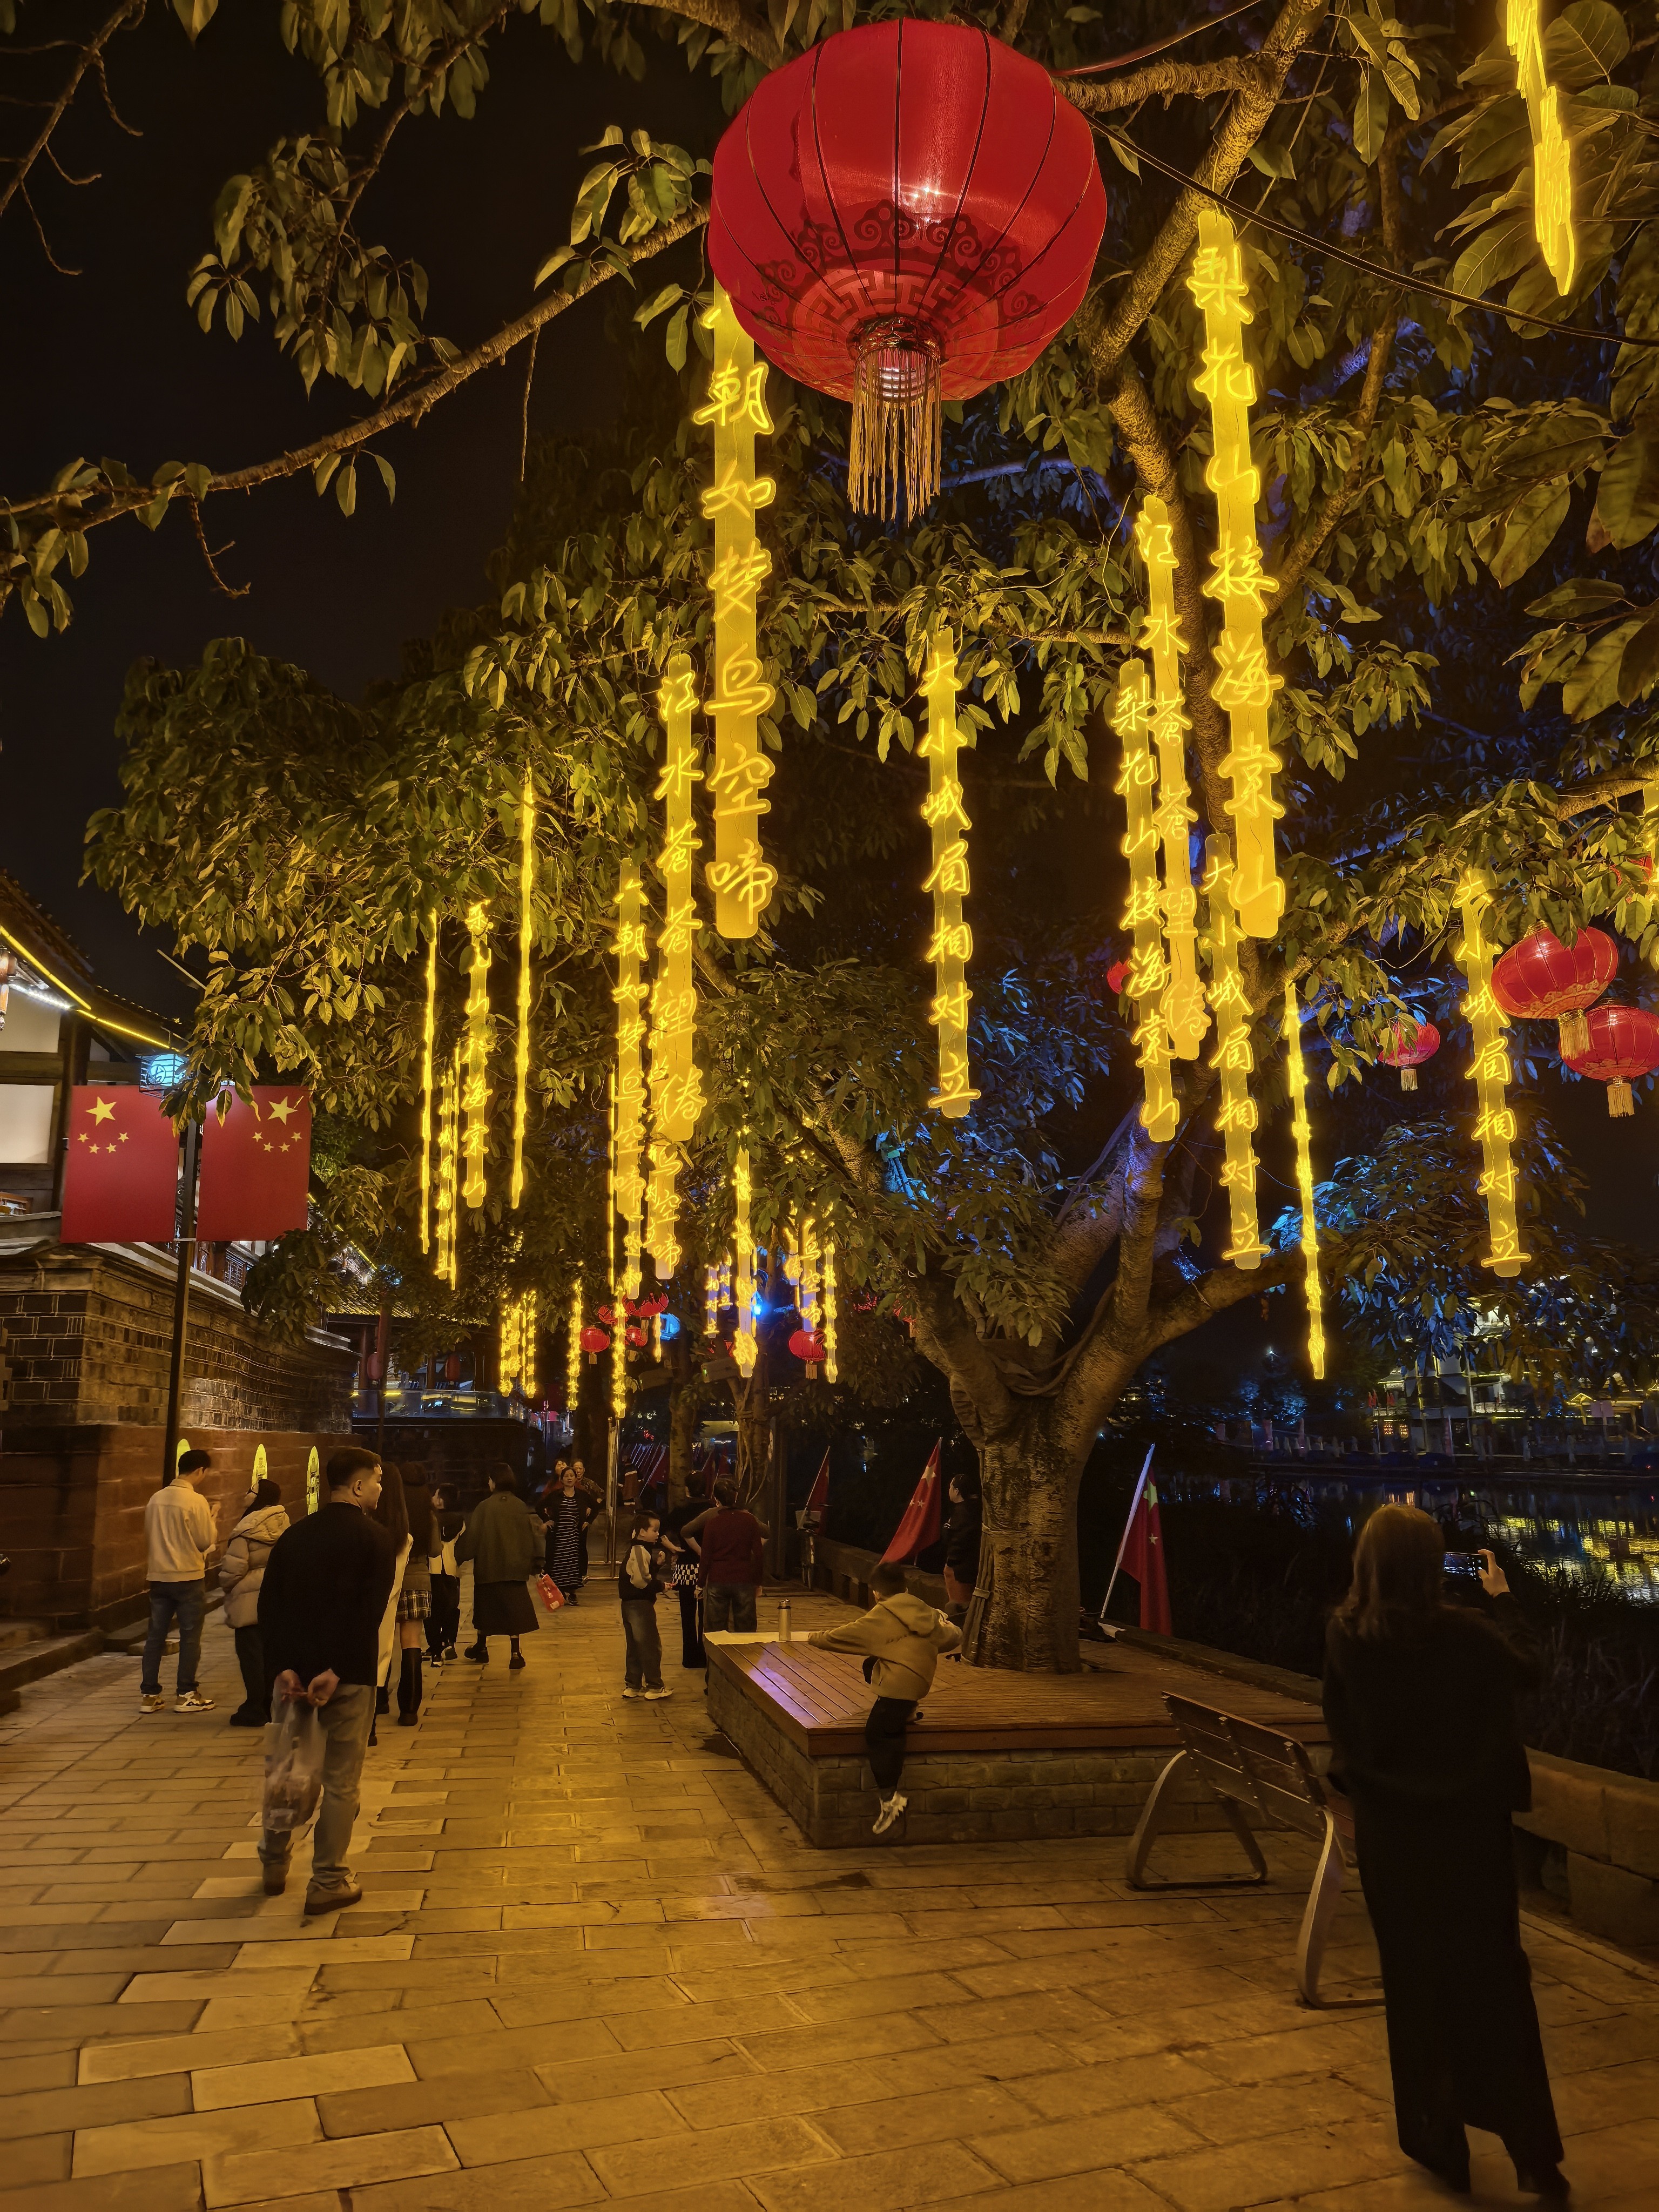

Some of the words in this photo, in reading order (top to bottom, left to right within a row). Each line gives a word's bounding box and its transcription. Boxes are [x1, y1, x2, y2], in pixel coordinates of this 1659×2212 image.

[698, 294, 772, 925] 朝如梦鸟空啼
[1190, 246, 1284, 917] 梨花山接海棠山
